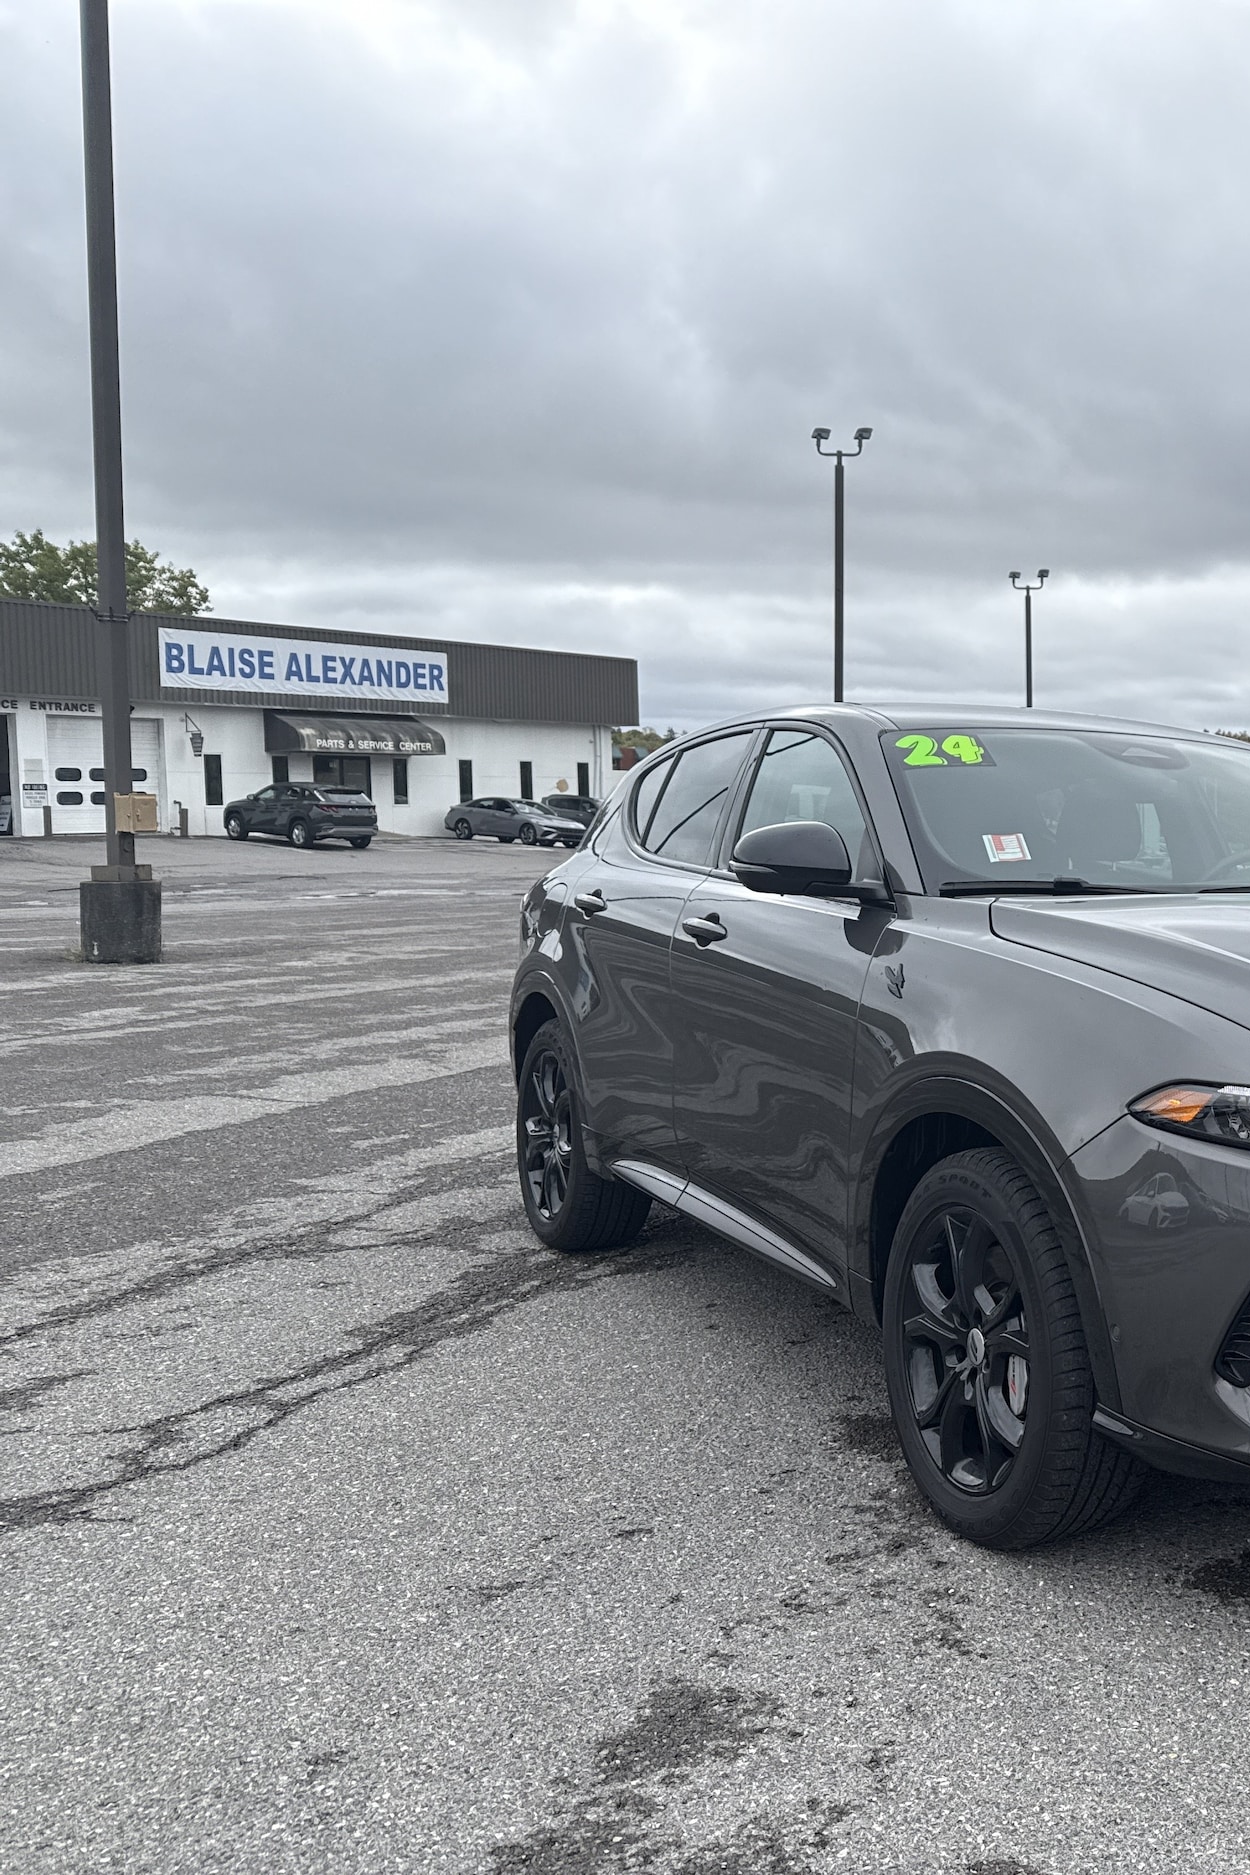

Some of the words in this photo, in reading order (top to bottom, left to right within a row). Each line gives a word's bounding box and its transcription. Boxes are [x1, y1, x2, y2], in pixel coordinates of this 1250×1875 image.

[165, 642, 275, 680] BLAISE
[285, 652, 445, 691] ALEXANDER
[30, 701, 96, 712] ENTRANCE
[316, 739, 345, 749] PARTS
[348, 740, 354, 749] &
[358, 740, 394, 750] SERVICE
[399, 741, 432, 751] CENTER
[895, 734, 984, 766] 24
